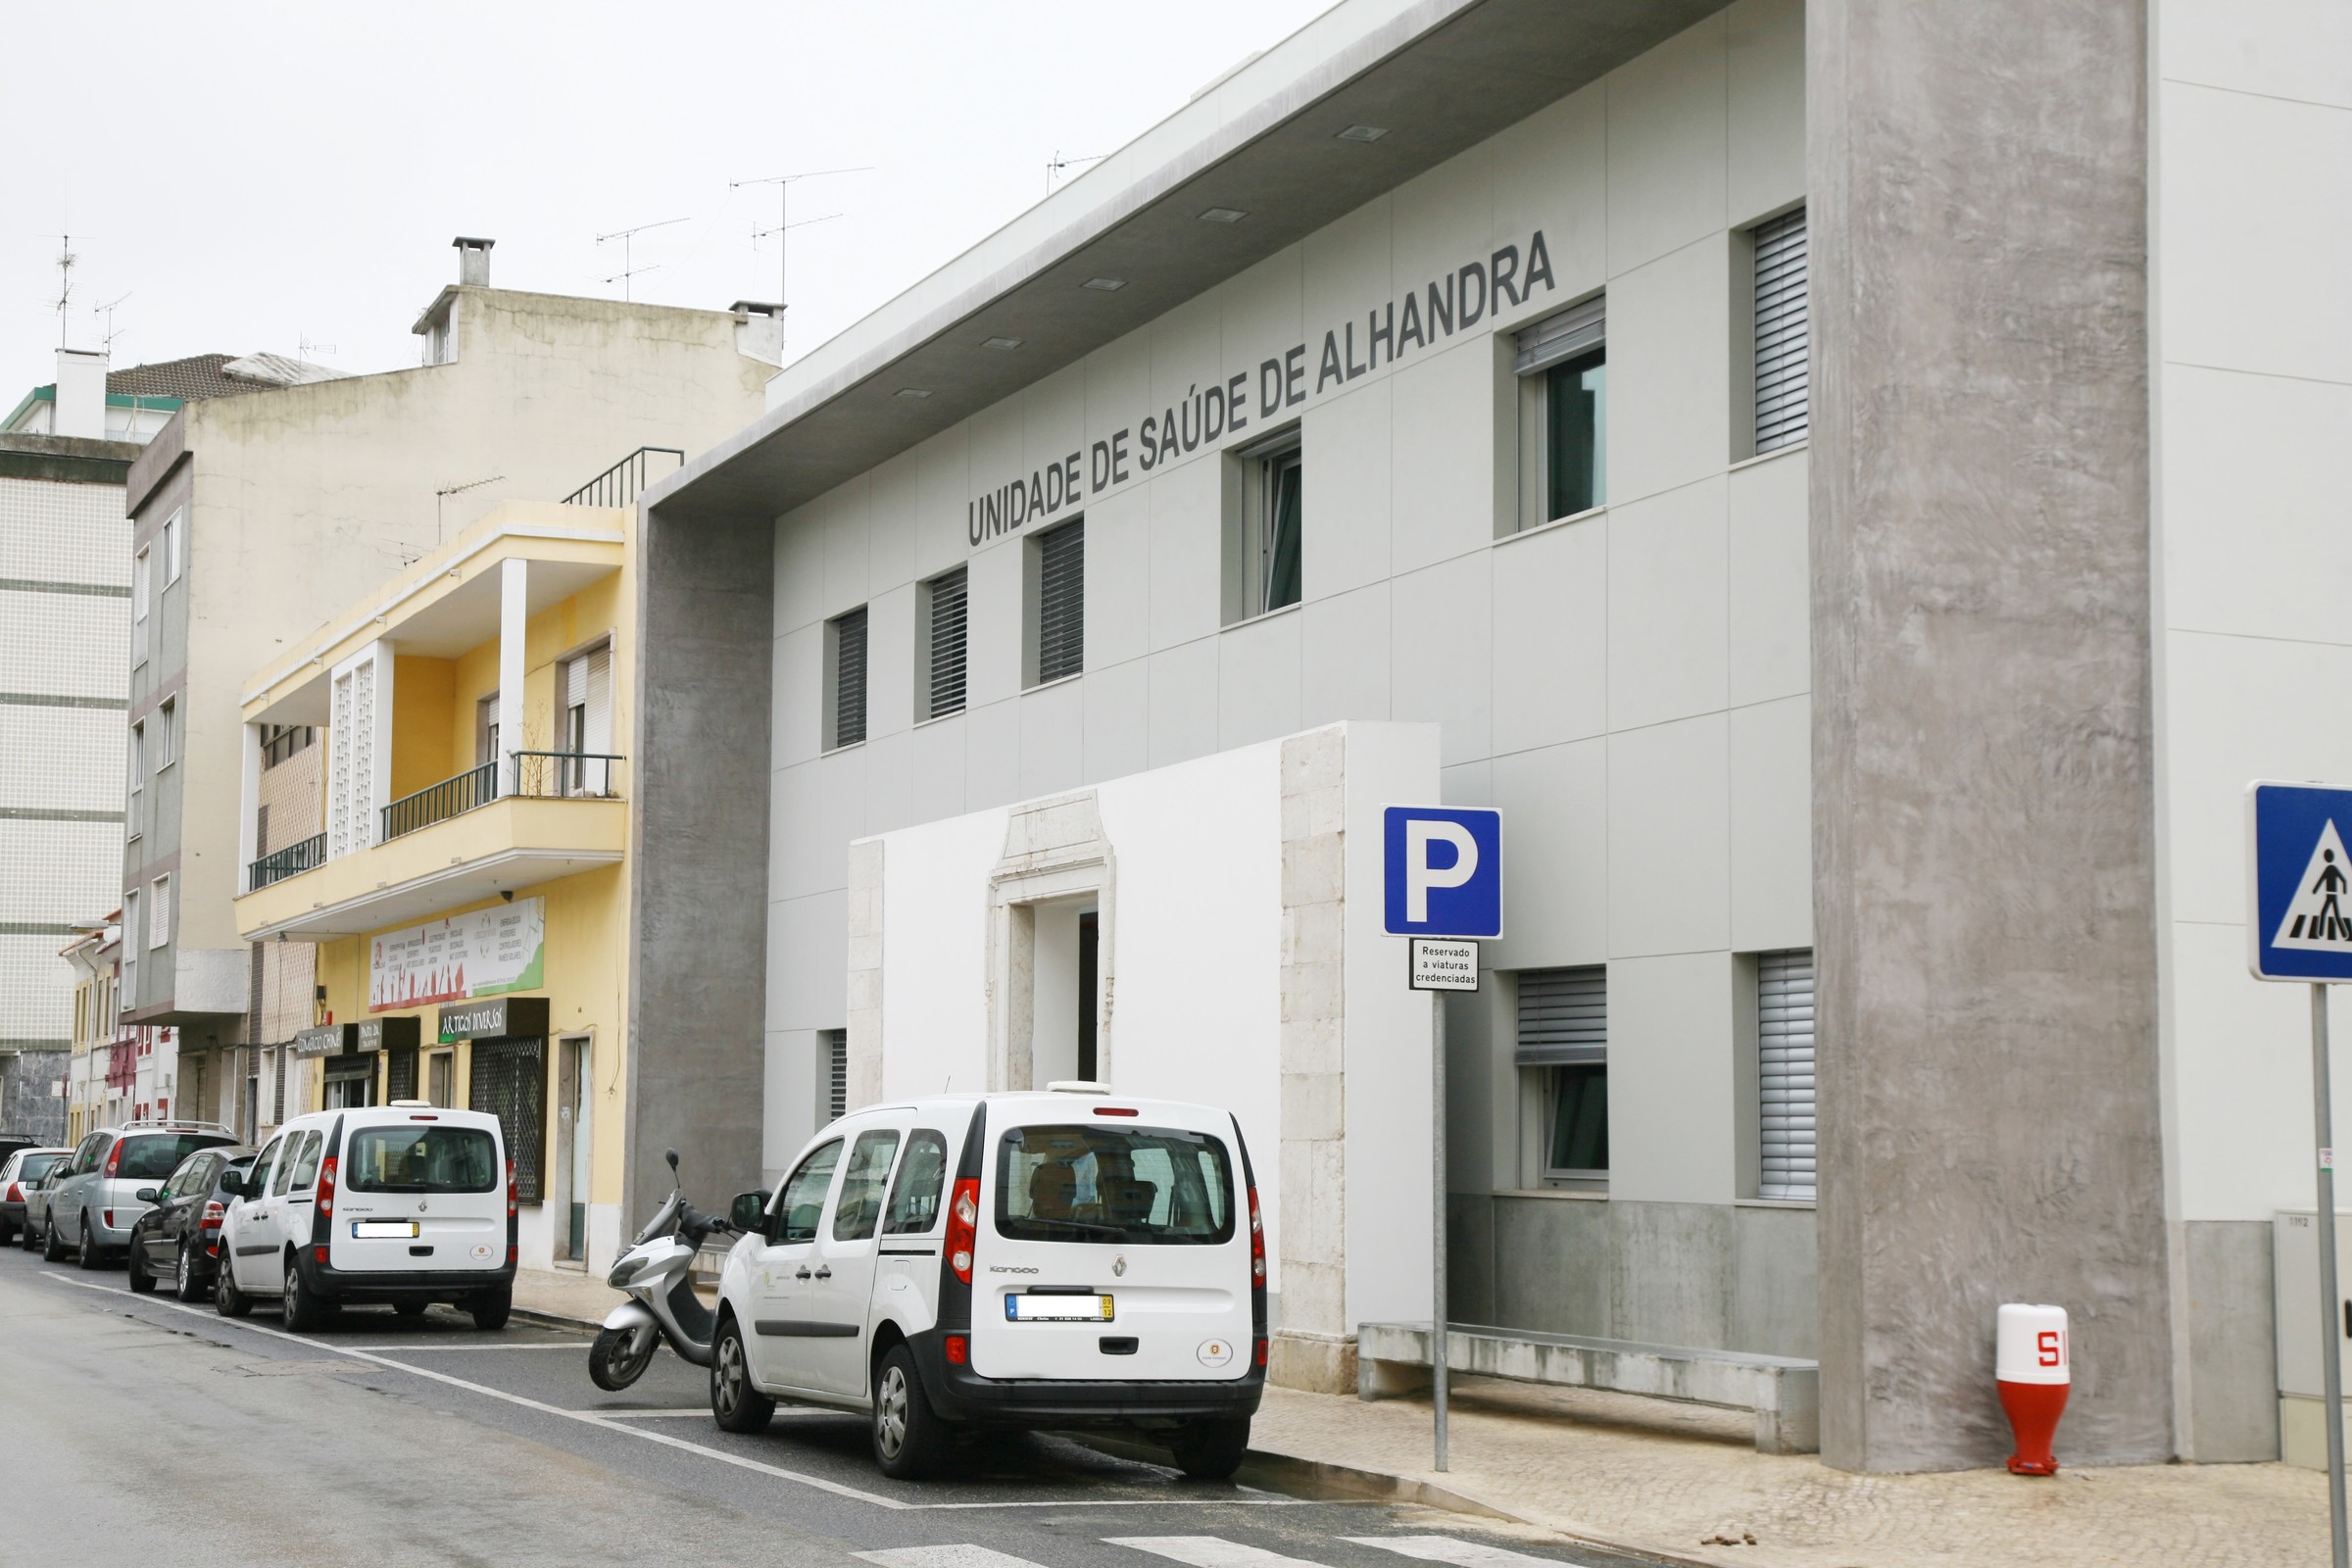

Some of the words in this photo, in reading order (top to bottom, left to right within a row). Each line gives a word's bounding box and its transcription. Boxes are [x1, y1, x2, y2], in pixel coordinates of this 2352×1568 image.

[969, 451, 1082, 547] UNIDADE
[1092, 427, 1129, 495] DE
[1139, 371, 1247, 470] SAÚDE
[1260, 343, 1306, 418] DE
[1316, 229, 1556, 395] ALHANDRA
[1406, 819, 1479, 923] P
[1422, 946, 1470, 957] Reservado
[1432, 960, 1469, 970] viaturas
[1415, 973, 1476, 984] credenciadas
[472, 1006, 503, 1031] DIVERSOS
